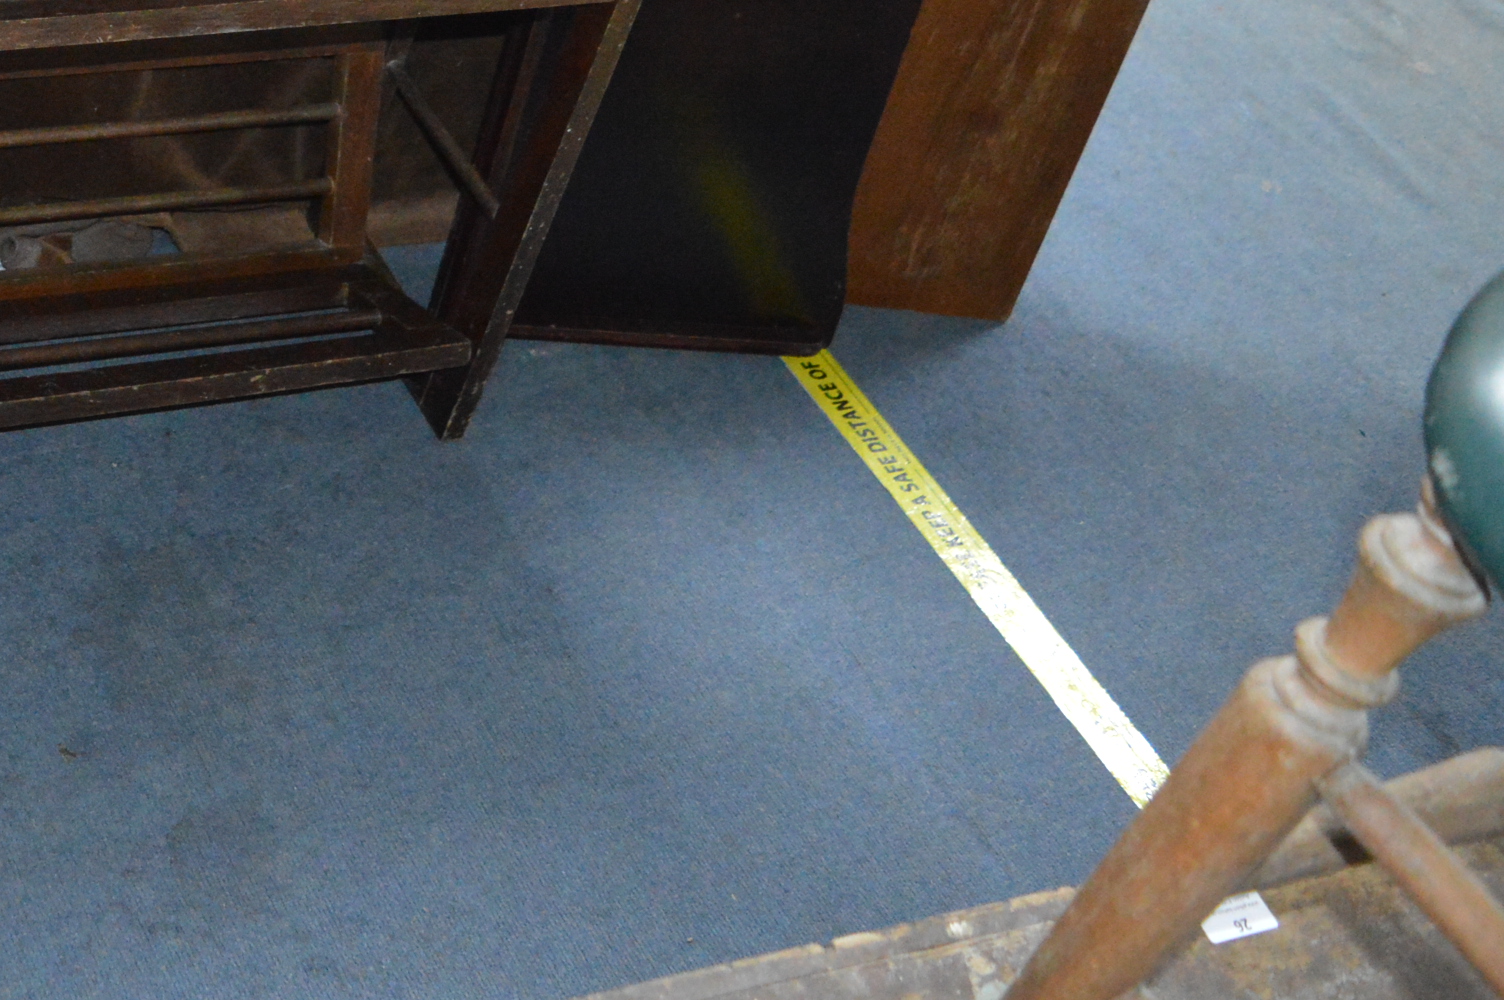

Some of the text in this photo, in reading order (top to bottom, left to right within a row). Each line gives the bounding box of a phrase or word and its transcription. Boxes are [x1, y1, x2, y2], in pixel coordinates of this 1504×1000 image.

[801, 361, 829, 384] OF
[820, 381, 888, 454] DISTANCE
[879, 455, 919, 493] SAFE
[911, 492, 931, 508] A
